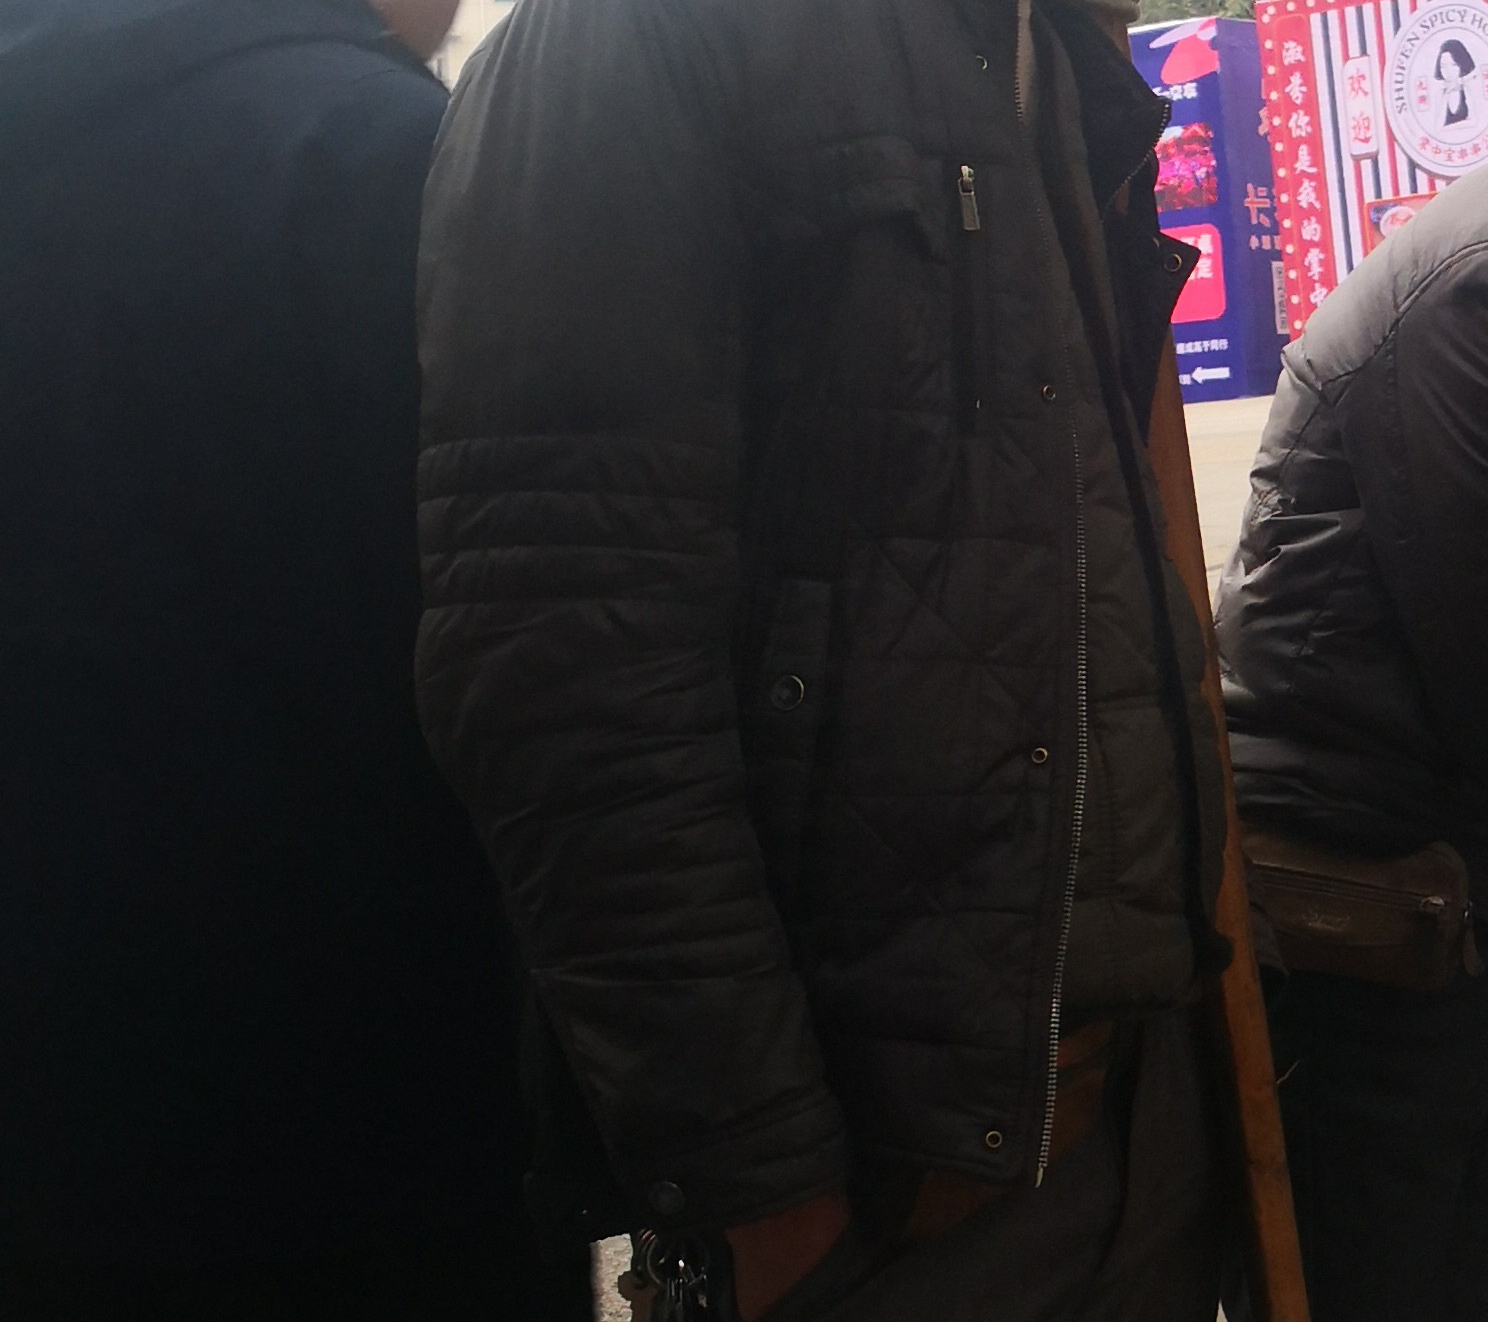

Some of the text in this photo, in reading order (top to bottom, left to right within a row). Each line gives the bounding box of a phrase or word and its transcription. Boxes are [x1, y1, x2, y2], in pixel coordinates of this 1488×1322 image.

[1347, 67, 1373, 145] 欢迎
[1393, 31, 1421, 115] SHUFEN
[1418, 8, 1468, 35] SPICY
